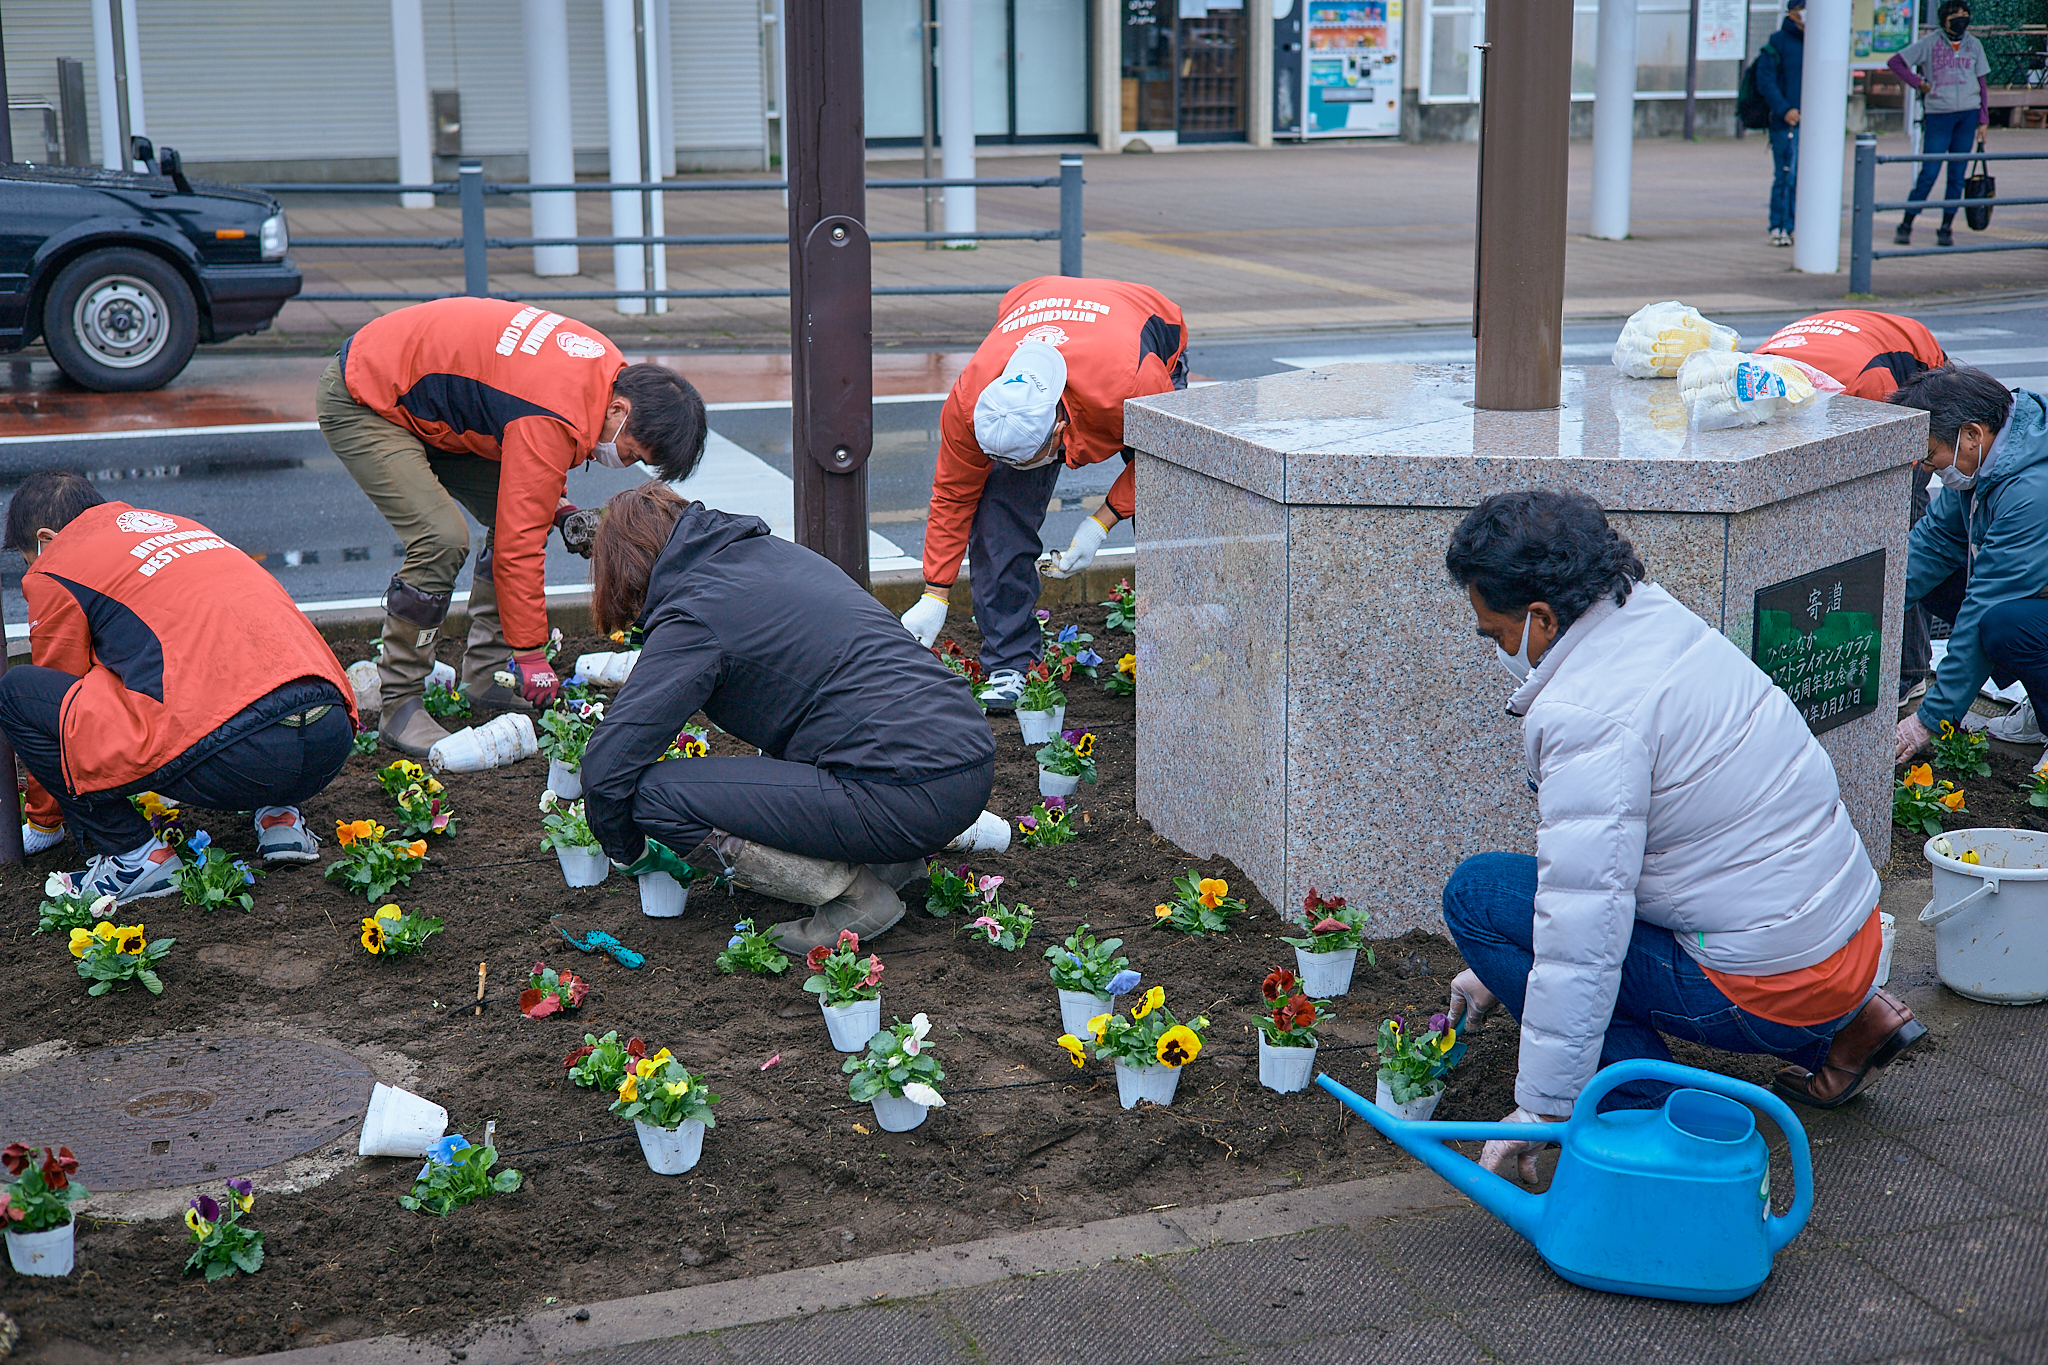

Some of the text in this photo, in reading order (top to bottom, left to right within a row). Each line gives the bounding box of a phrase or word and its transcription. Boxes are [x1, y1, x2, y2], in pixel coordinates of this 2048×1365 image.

[1027, 297, 1072, 312] LIONS
[1073, 299, 1111, 316] BEST
[1002, 309, 1097, 334] HITACHINAKA
[1823, 319, 1861, 333] BEST
[496, 326, 523, 357] CLUB
[129, 529, 222, 560] HITACHINA
[137, 546, 182, 578] BEST
[175, 538, 225, 555] LIONS
[1767, 631, 1818, 665] ひたちなか
[1782, 654, 1870, 703] 25周年記念事業
